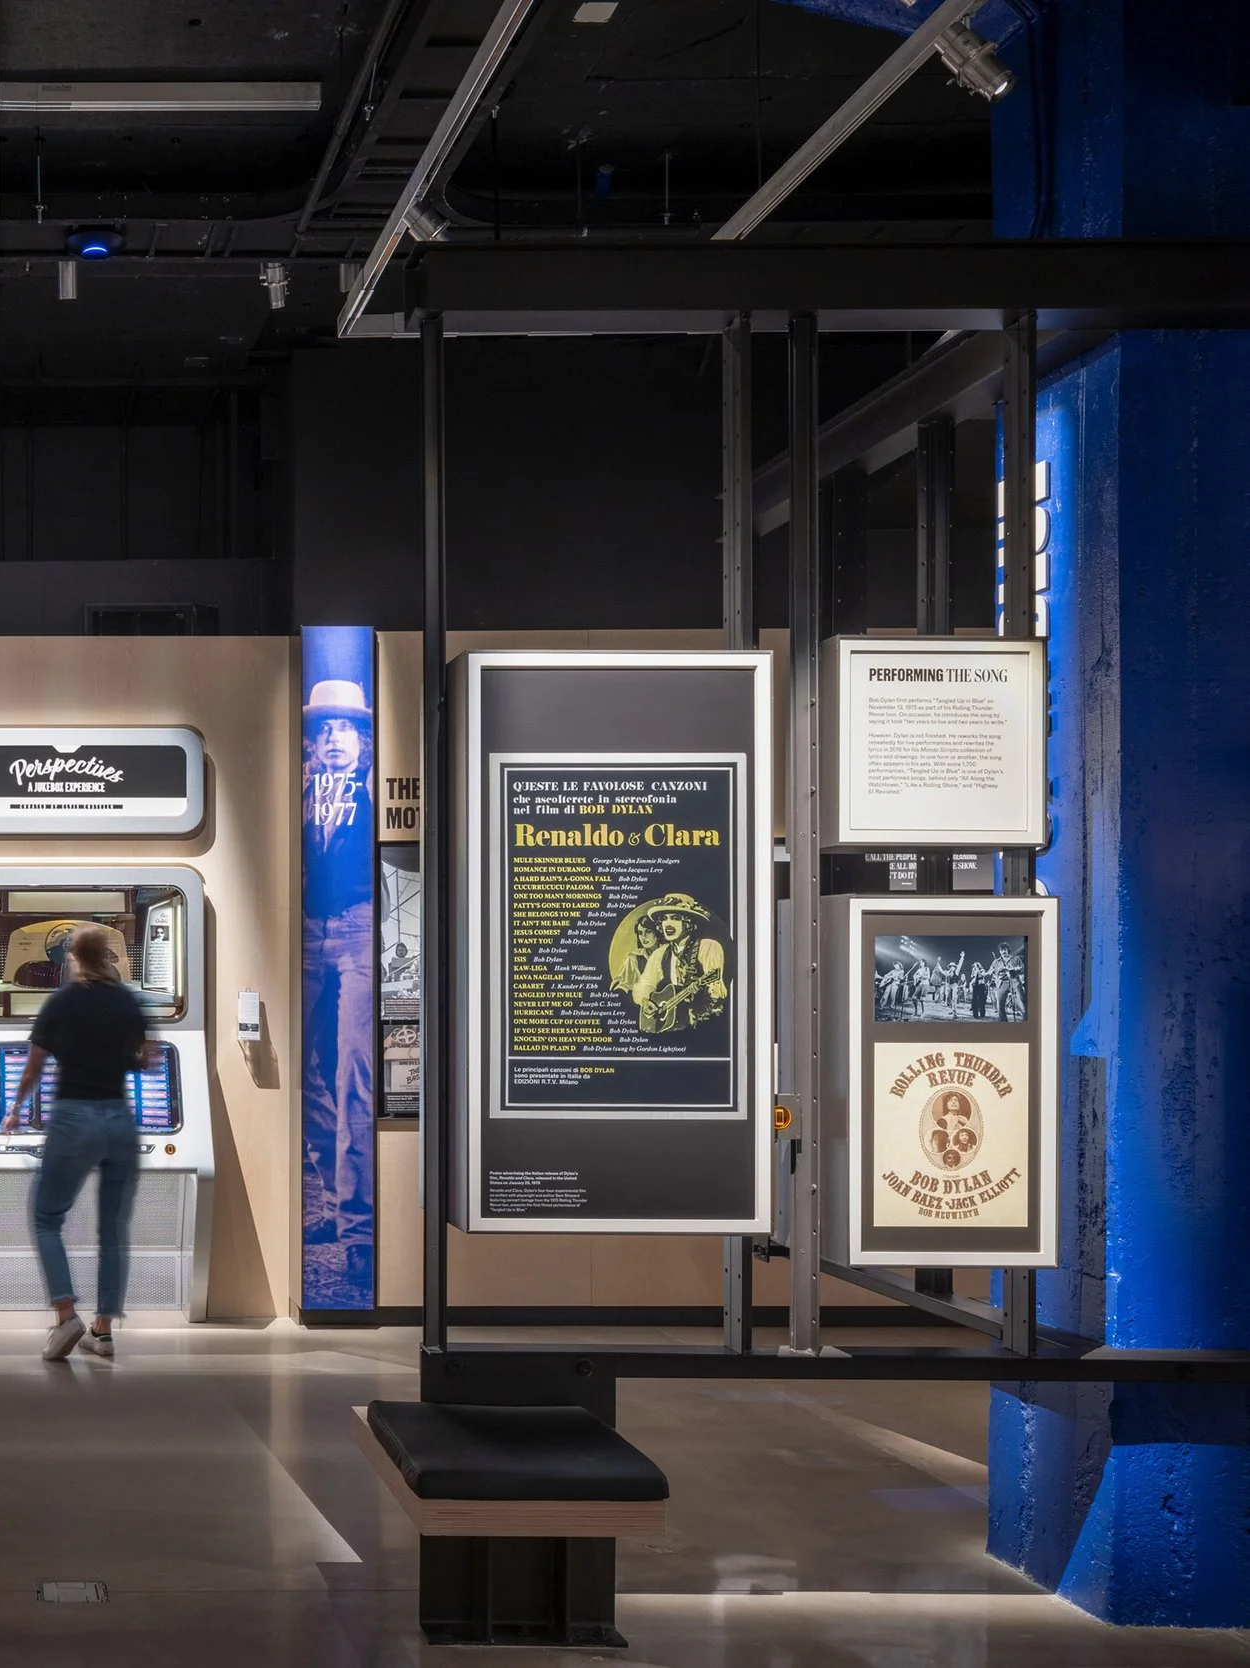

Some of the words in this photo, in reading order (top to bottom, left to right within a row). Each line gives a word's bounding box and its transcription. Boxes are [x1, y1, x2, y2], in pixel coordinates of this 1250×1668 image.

[869, 667, 944, 682] PERFORMING
[946, 668, 972, 682] THE
[974, 669, 1008, 683] SONG
[9, 756, 124, 786] Perspectives
[27, 782, 33, 792] A
[34, 782, 64, 792] JUKEBOX
[65, 782, 105, 792] EXPERIENCE
[313, 772, 363, 796] 1975-
[386, 778, 420, 800] THE
[513, 781, 559, 792] QUESTE
[562, 781, 578, 791] LE
[583, 781, 644, 791] FAVOLOSE
[651, 781, 708, 791] CANZONI
[513, 795, 531, 804] che
[535, 795, 594, 804] ascolterete
[598, 795, 610, 804] in
[615, 795, 677, 804] stereofonia
[513, 805, 530, 815] nel
[536, 805, 560, 815] film
[564, 805, 575, 814] di
[579, 804, 605, 814] BOB
[612, 804, 653, 814] DYLAN
[313, 802, 358, 826] 1977
[514, 823, 625, 847] Renaldo
[628, 832, 641, 847] &
[644, 823, 720, 847] Clara
[592, 857, 613, 865] George
[614, 857, 635, 865] Vaughn
[657, 857, 680, 865] Rodgers
[889, 1052, 946, 1099] ROLLING
[953, 1051, 1013, 1099] THUNDER
[925, 1069, 977, 1088] REVUE
[881, 1171, 912, 1198] JOAN
[910, 1190, 943, 1210] BAEZ
[948, 1195, 977, 1210] JACK
[978, 1167, 1023, 1204] ELLIOTT
[909, 1170, 939, 1193] BOB
[942, 1169, 993, 1195] DYLAN
[918, 1207, 933, 1218] BOB
[934, 1208, 980, 1220] NEUWIRTH
